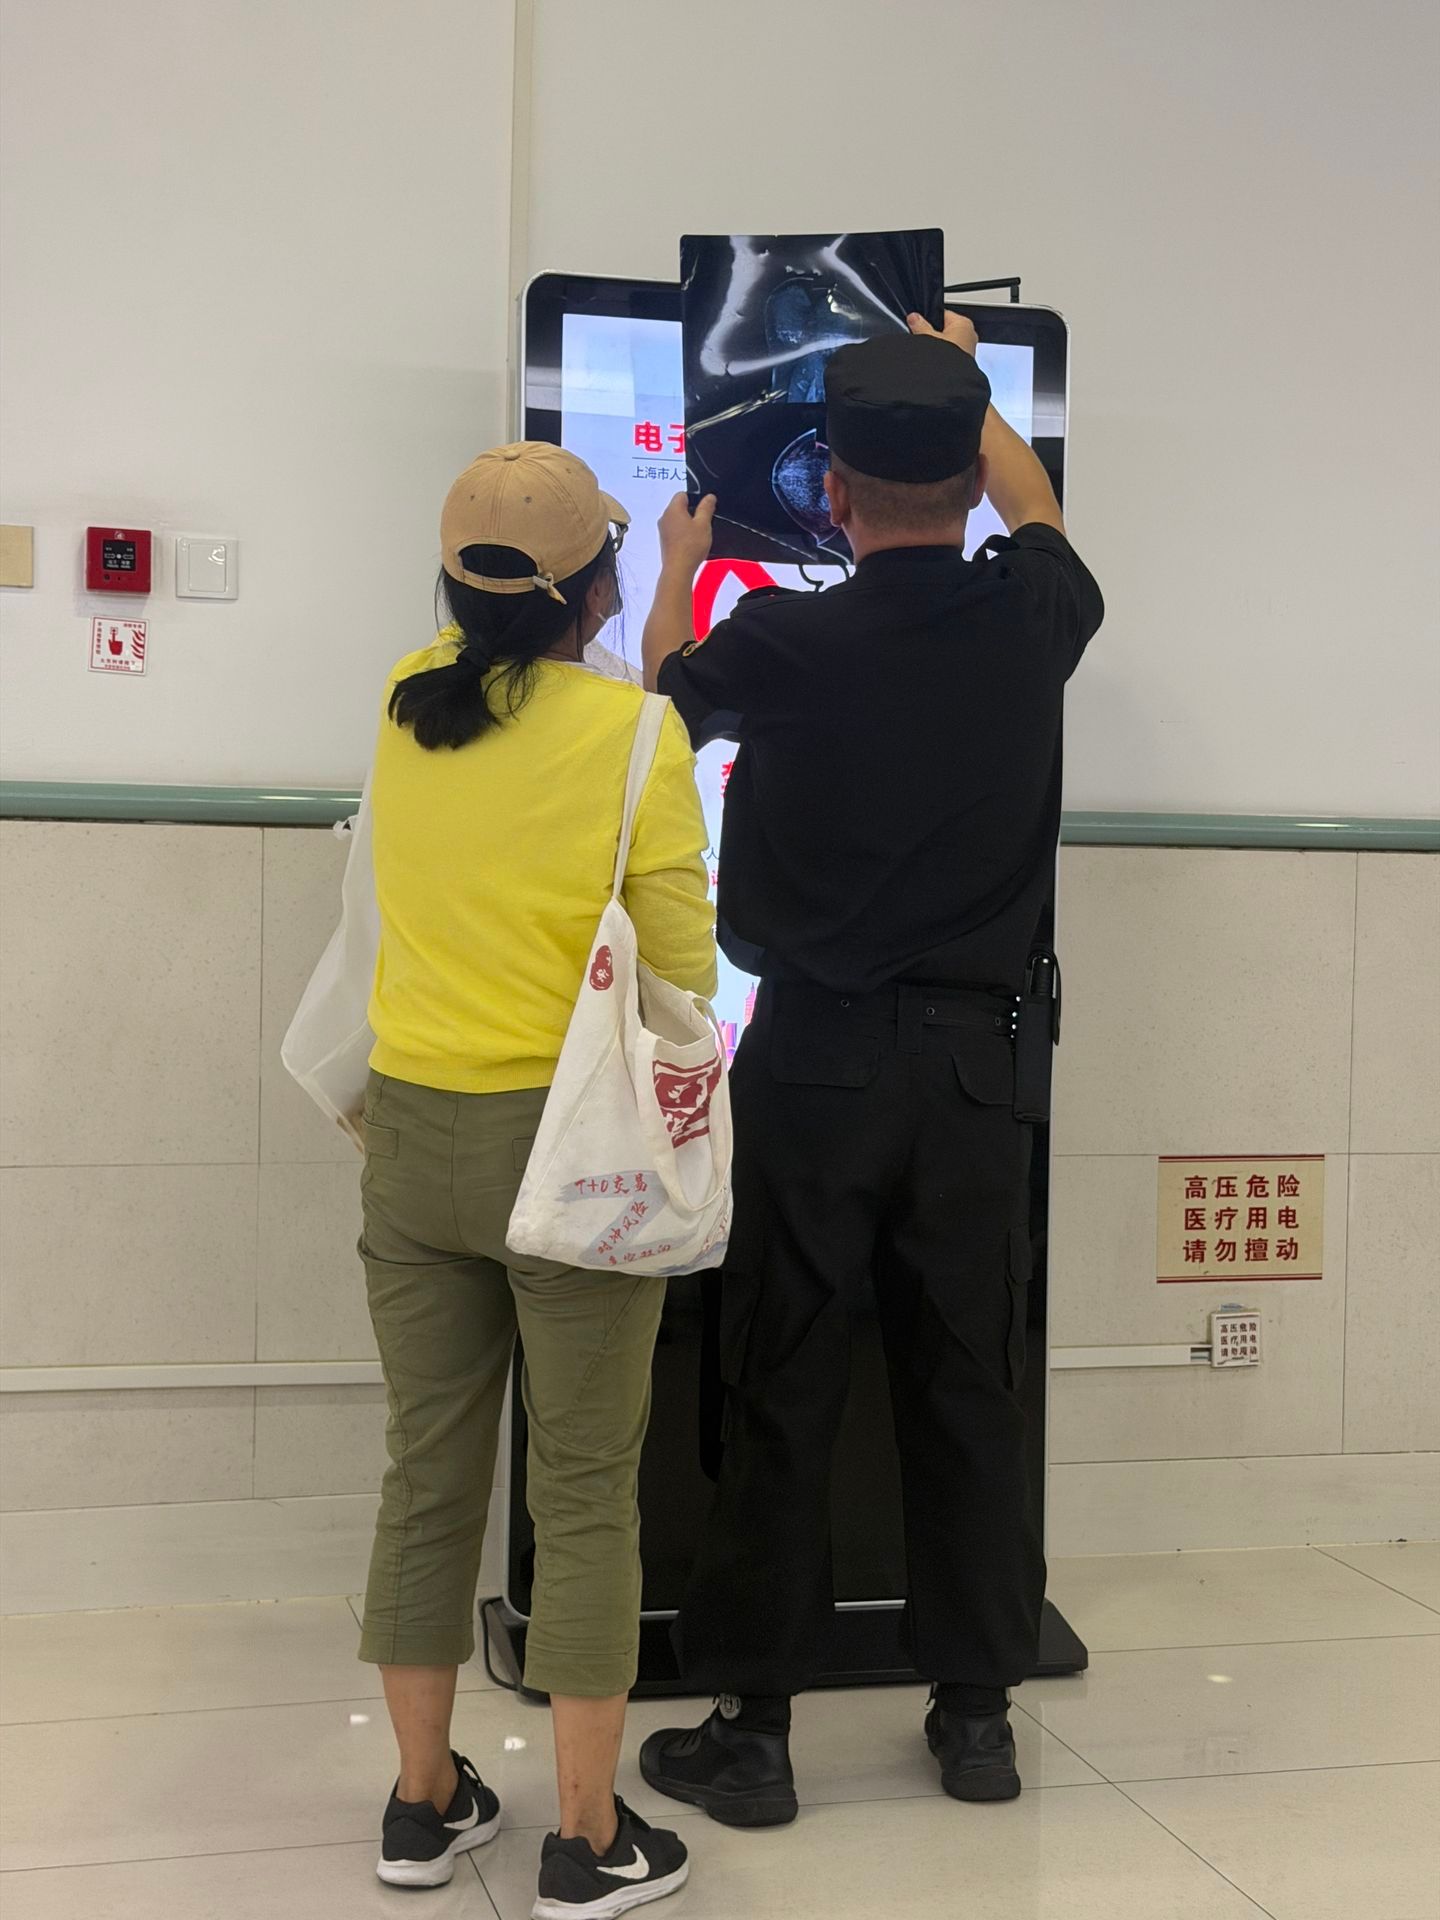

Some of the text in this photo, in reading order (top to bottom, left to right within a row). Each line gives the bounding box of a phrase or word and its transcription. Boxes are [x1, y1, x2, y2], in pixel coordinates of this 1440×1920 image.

[634, 421, 686, 454] 电子
[1184, 1174, 1301, 1200] 高压危险
[1184, 1206, 1300, 1231] 医疗用电
[1183, 1237, 1299, 1263] 请勿擅动
